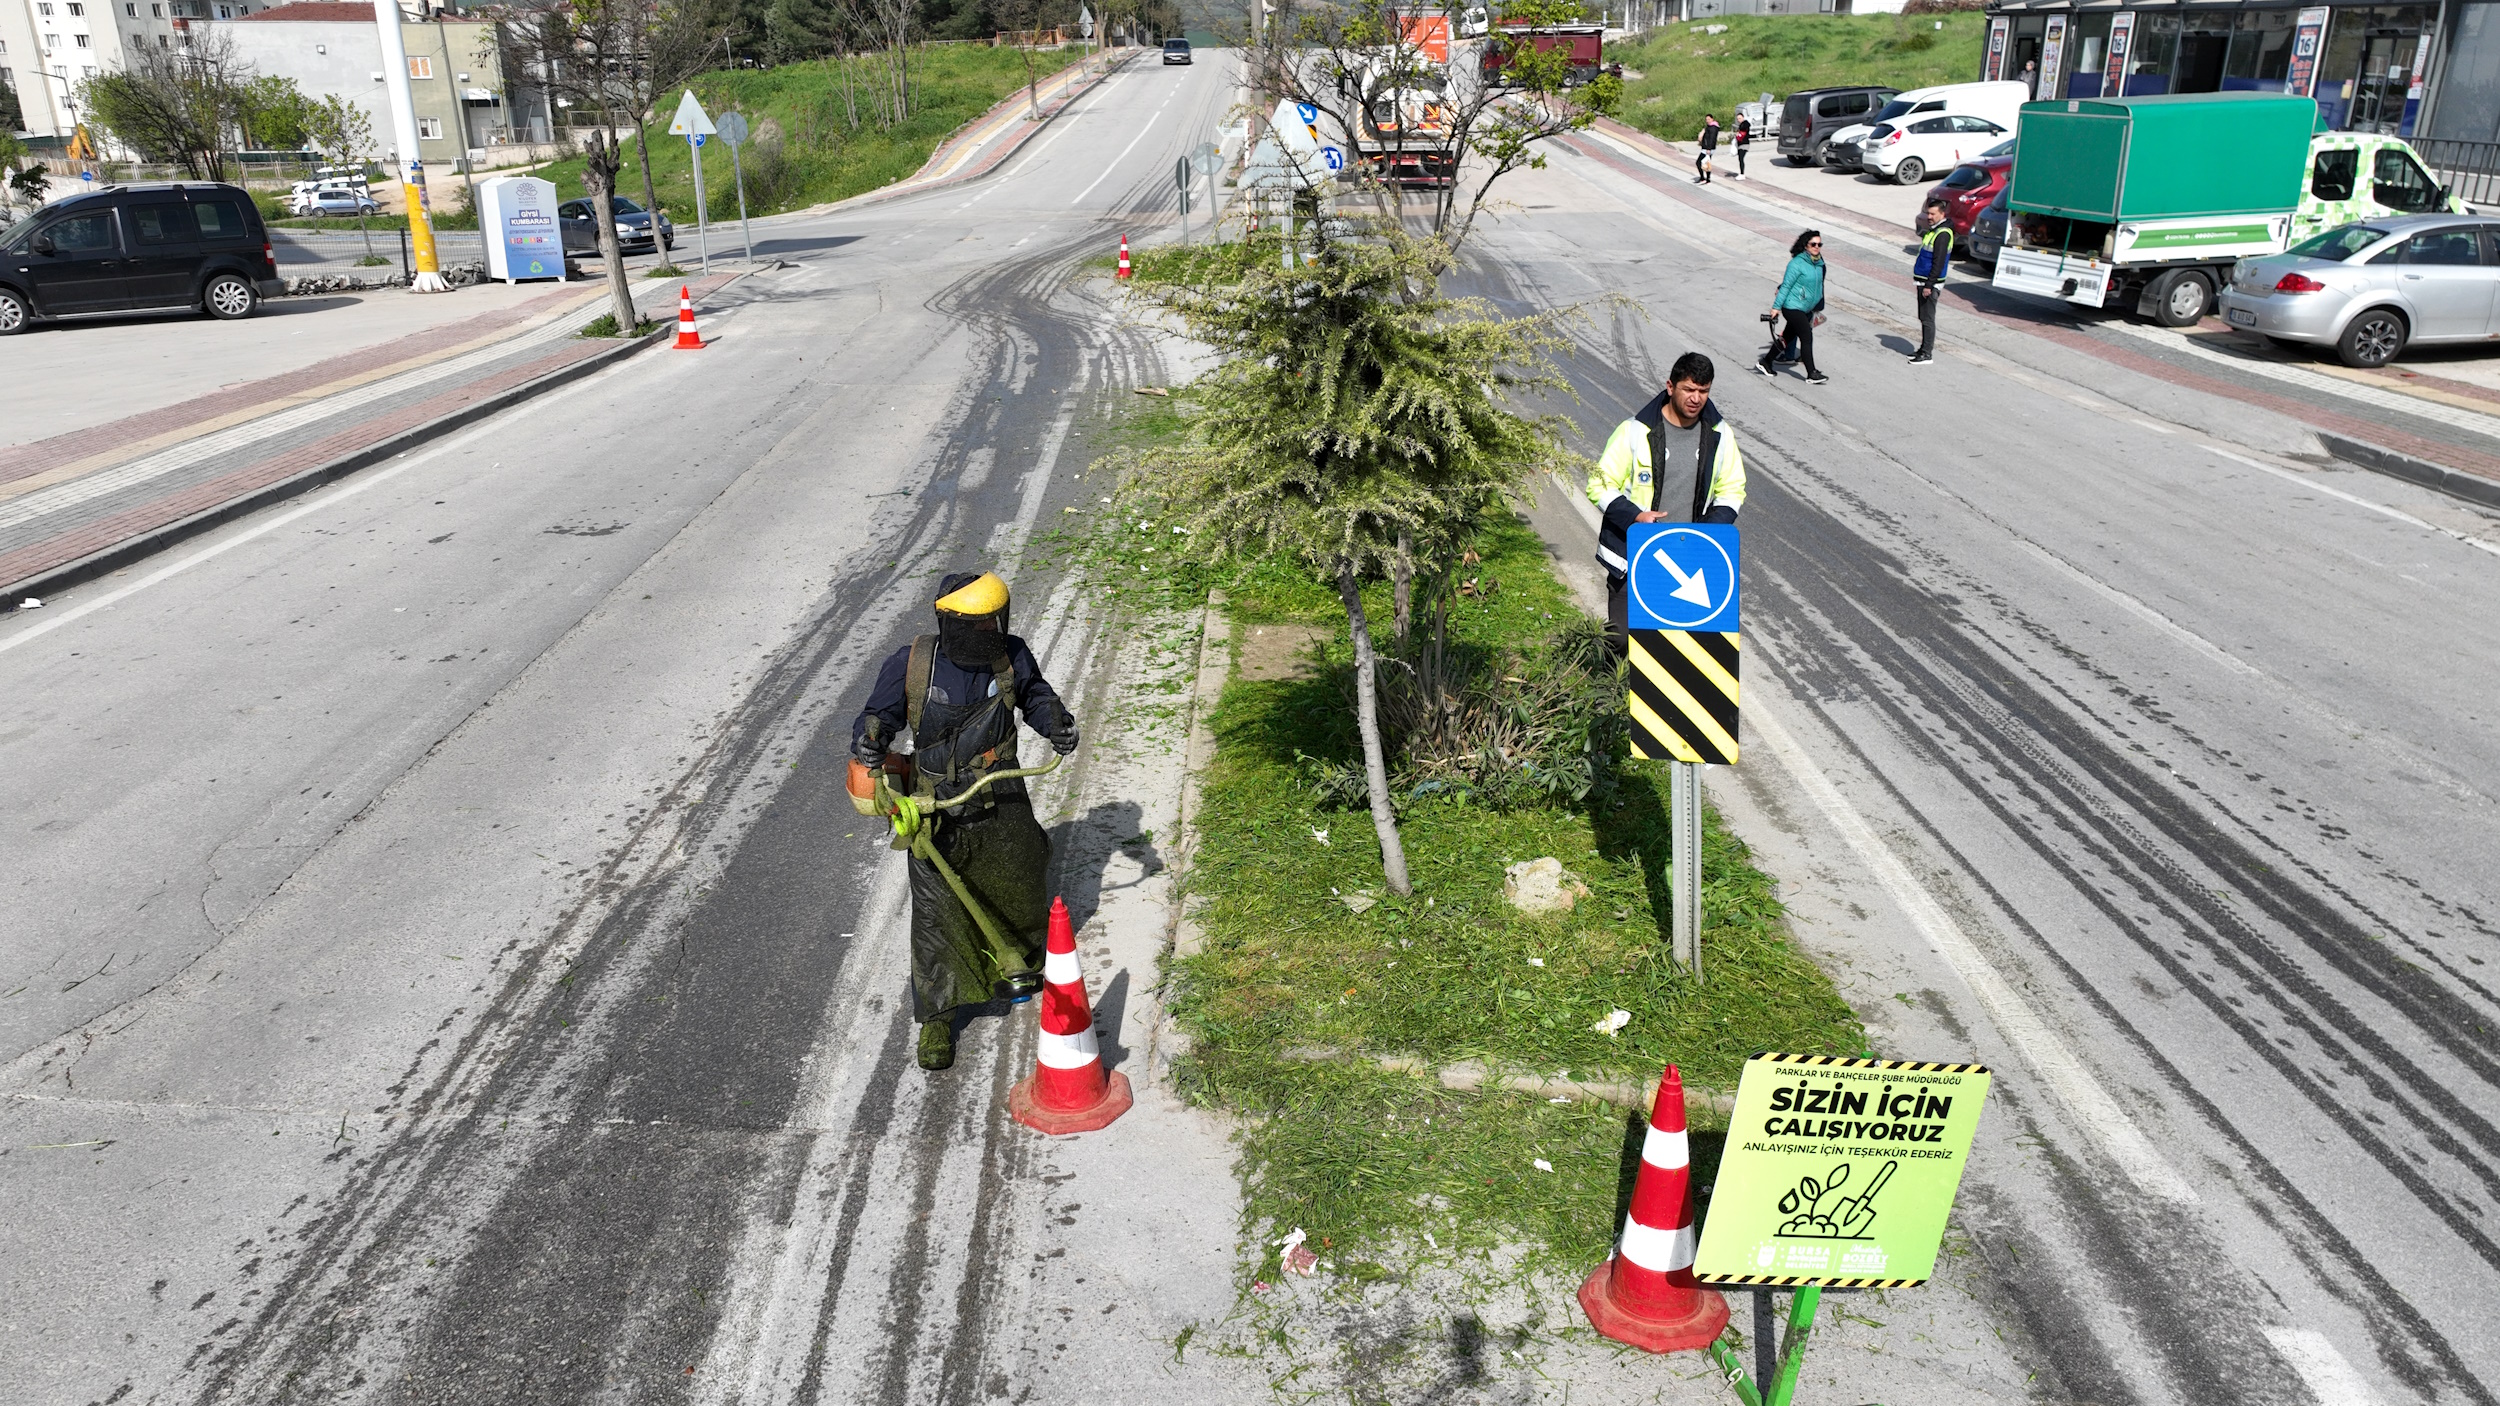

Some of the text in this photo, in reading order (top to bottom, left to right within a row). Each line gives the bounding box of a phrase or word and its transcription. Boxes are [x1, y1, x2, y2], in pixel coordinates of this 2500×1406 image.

[2300, 38, 2311, 53] 16
[1775, 1067, 1962, 1086] PARKLAR VE BAHÇELER ŞUBE MÜDÜRLÜĞÜ
[1769, 1079, 1953, 1122] SİZİN İÇİN
[1764, 1117, 1945, 1143] ÇALIŞIYORUZ
[1742, 1141, 1953, 1160] ANLAYIŞINIZ İÇİN TEŞEKKÜR EDERİZ
[1788, 1246, 1830, 1256] BURSA
